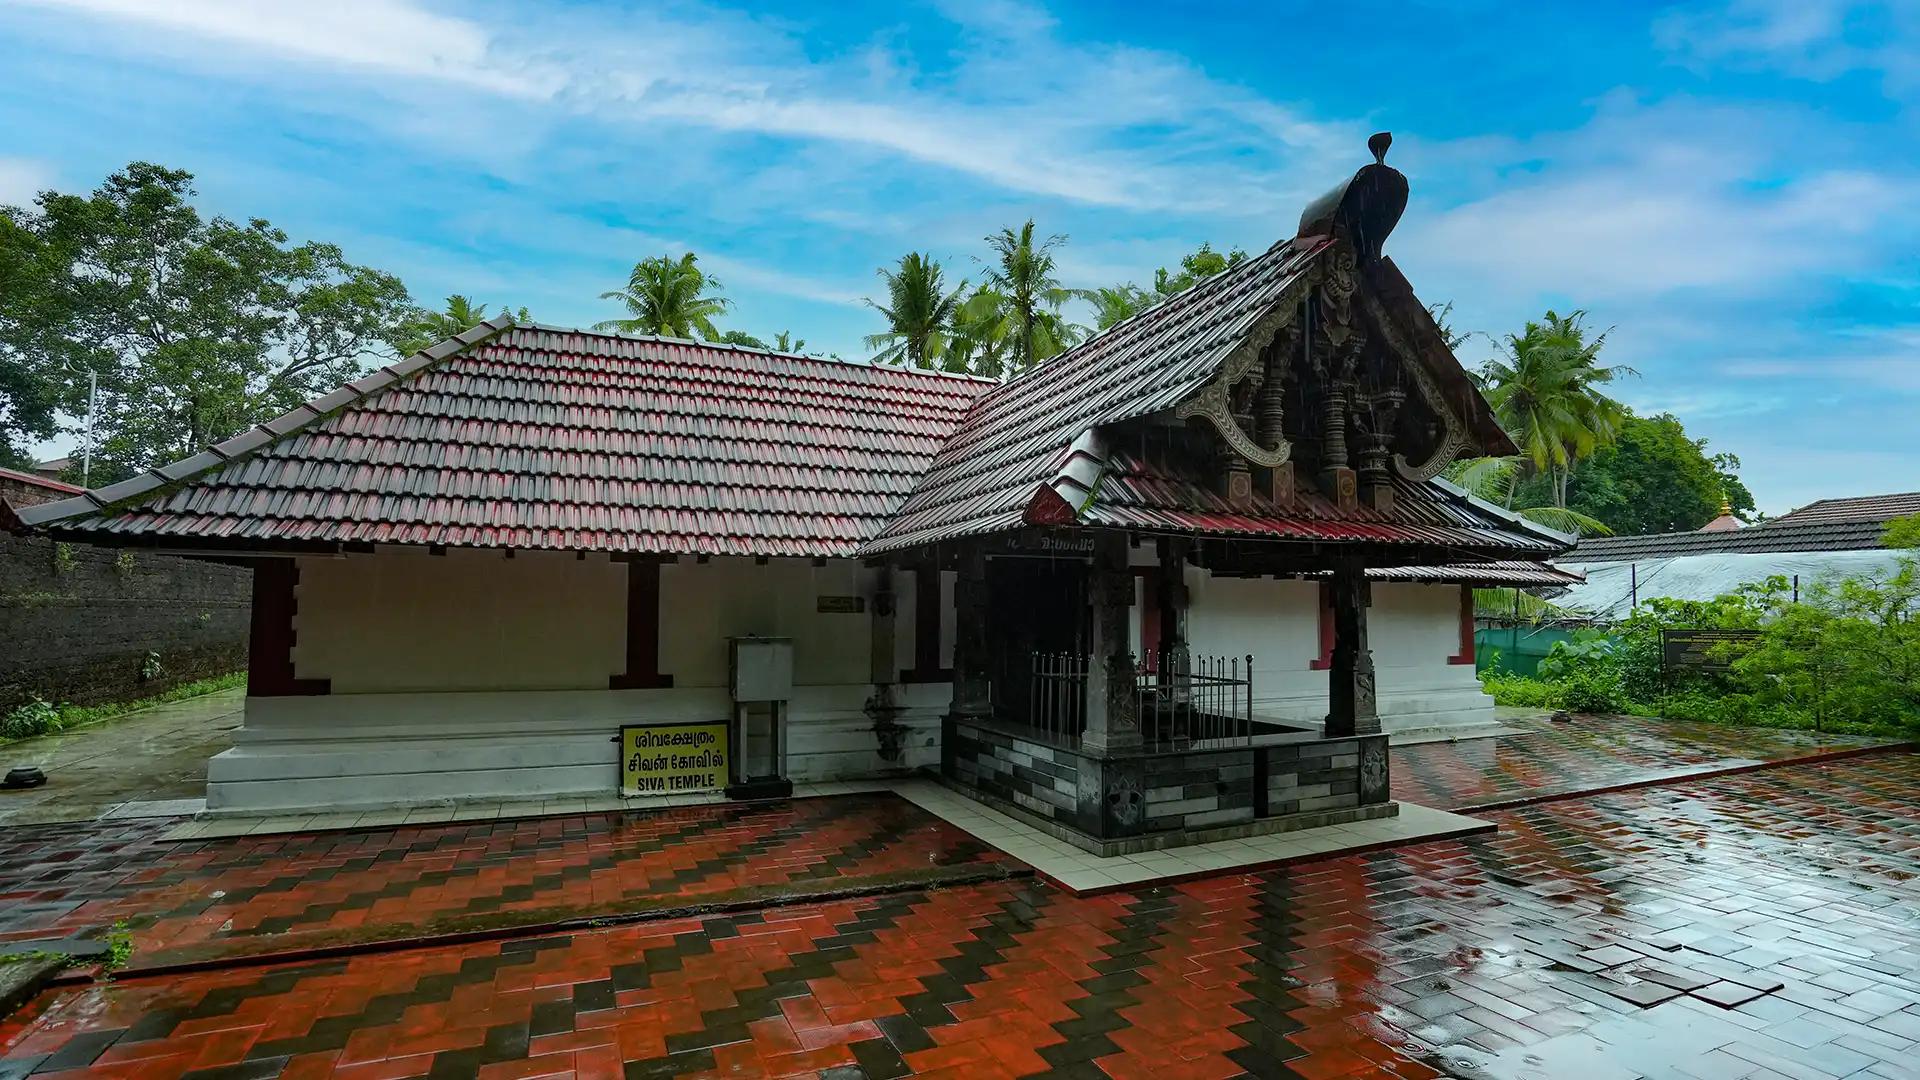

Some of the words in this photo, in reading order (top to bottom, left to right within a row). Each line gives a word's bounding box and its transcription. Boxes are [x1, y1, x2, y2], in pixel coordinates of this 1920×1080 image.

[635, 731, 715, 748] ശിവക്ഷേത്രം
[628, 752, 668, 771] சிவன்
[671, 749, 723, 769] கோவில்
[638, 777, 665, 791] SIVA
[668, 774, 715, 789] TEMPLE
